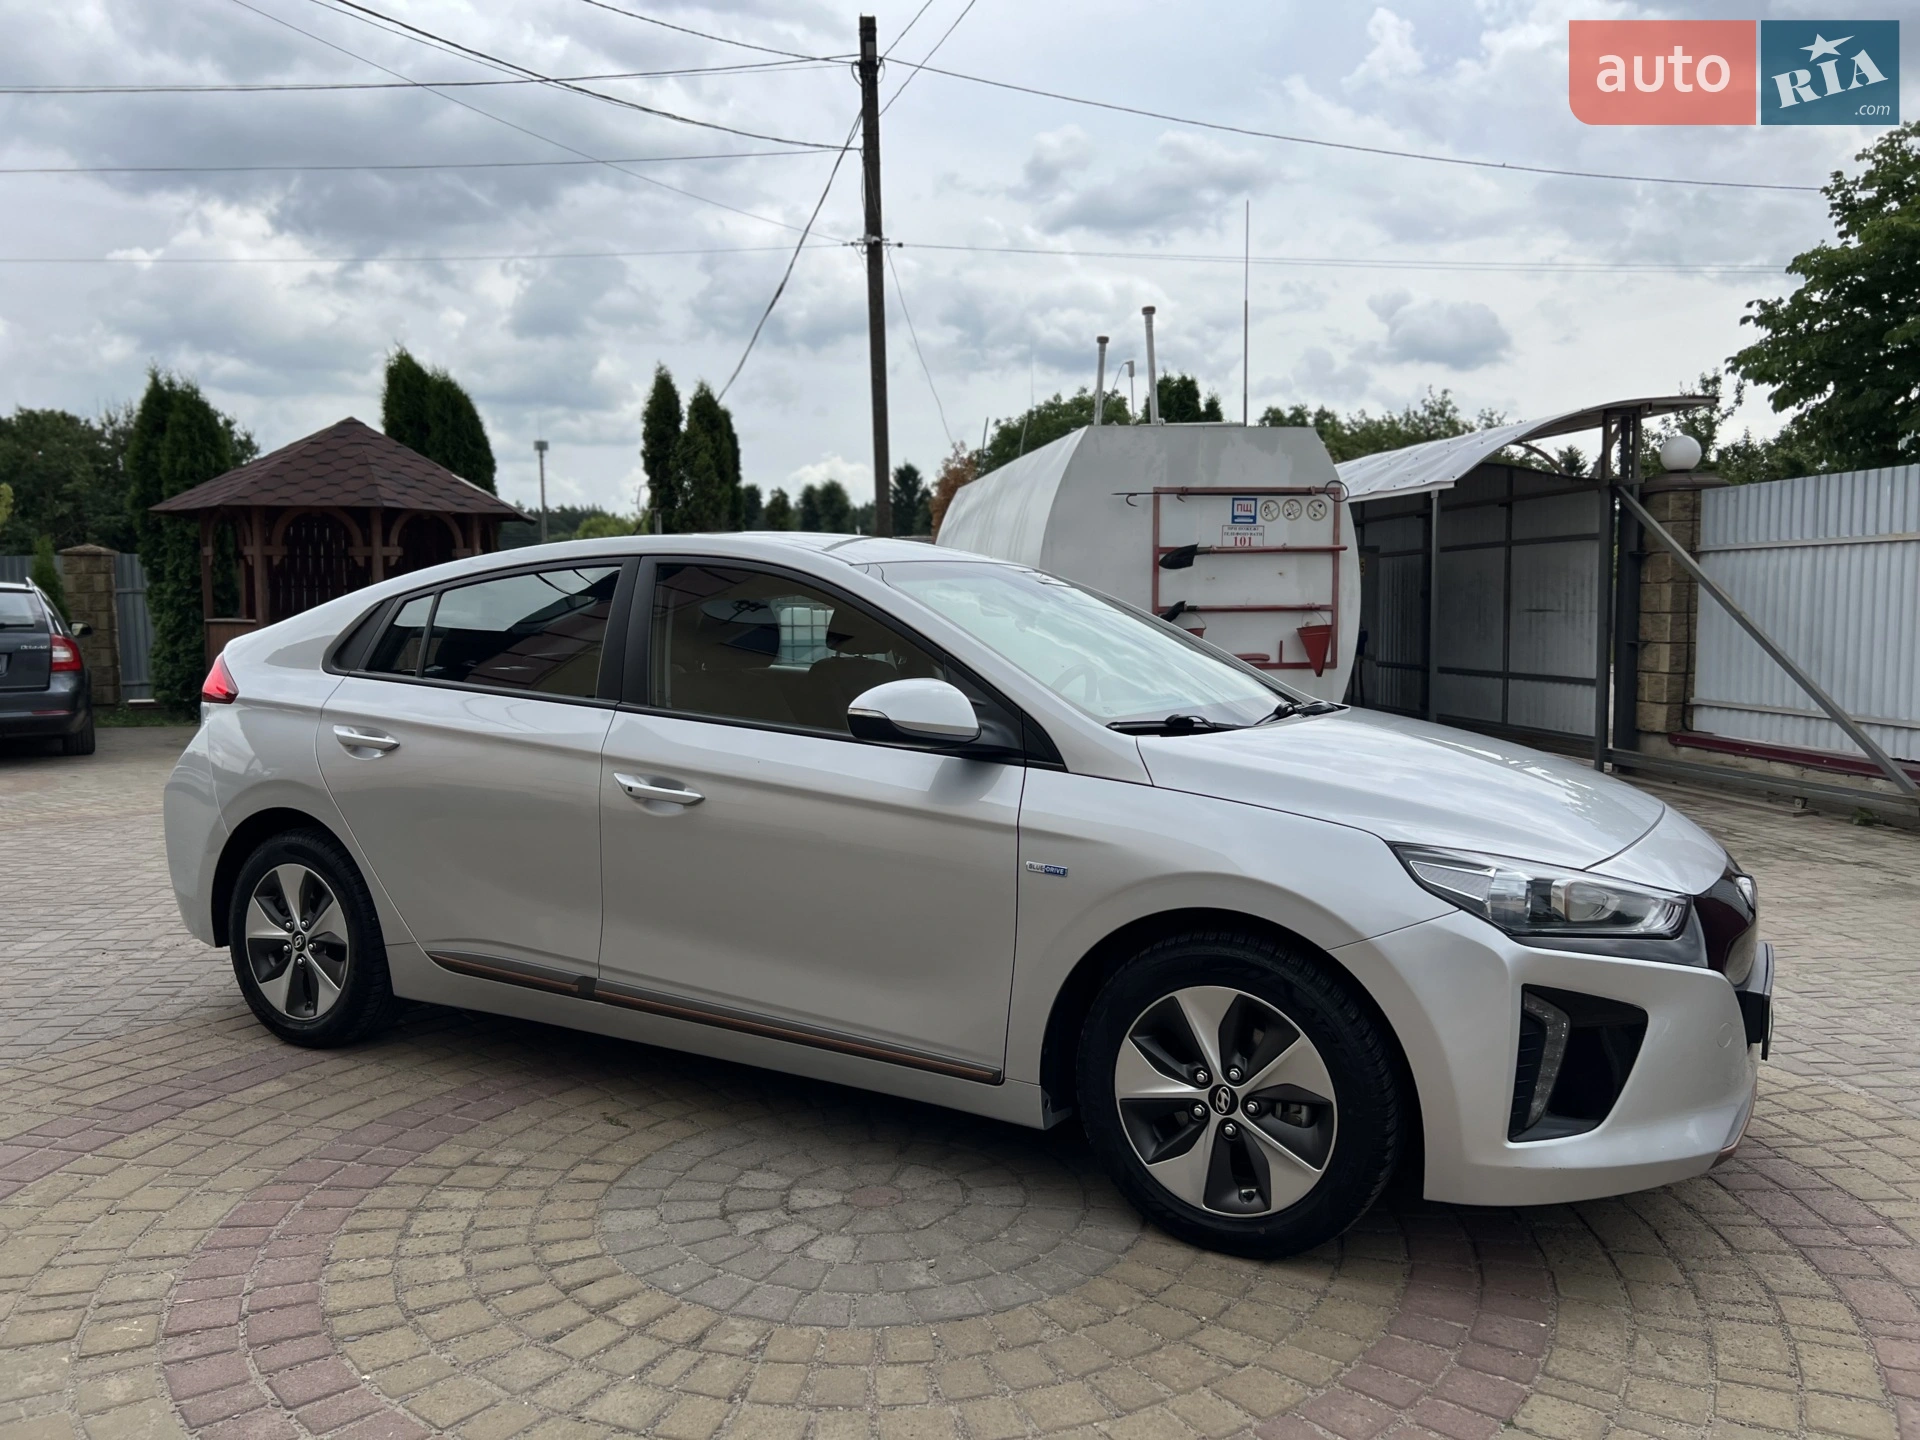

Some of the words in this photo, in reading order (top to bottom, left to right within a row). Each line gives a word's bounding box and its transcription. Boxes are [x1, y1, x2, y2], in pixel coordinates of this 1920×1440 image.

[1236, 503, 1253, 514] ПЩ
[1234, 536, 1252, 547] 101
[1028, 863, 1044, 871] BLUE
